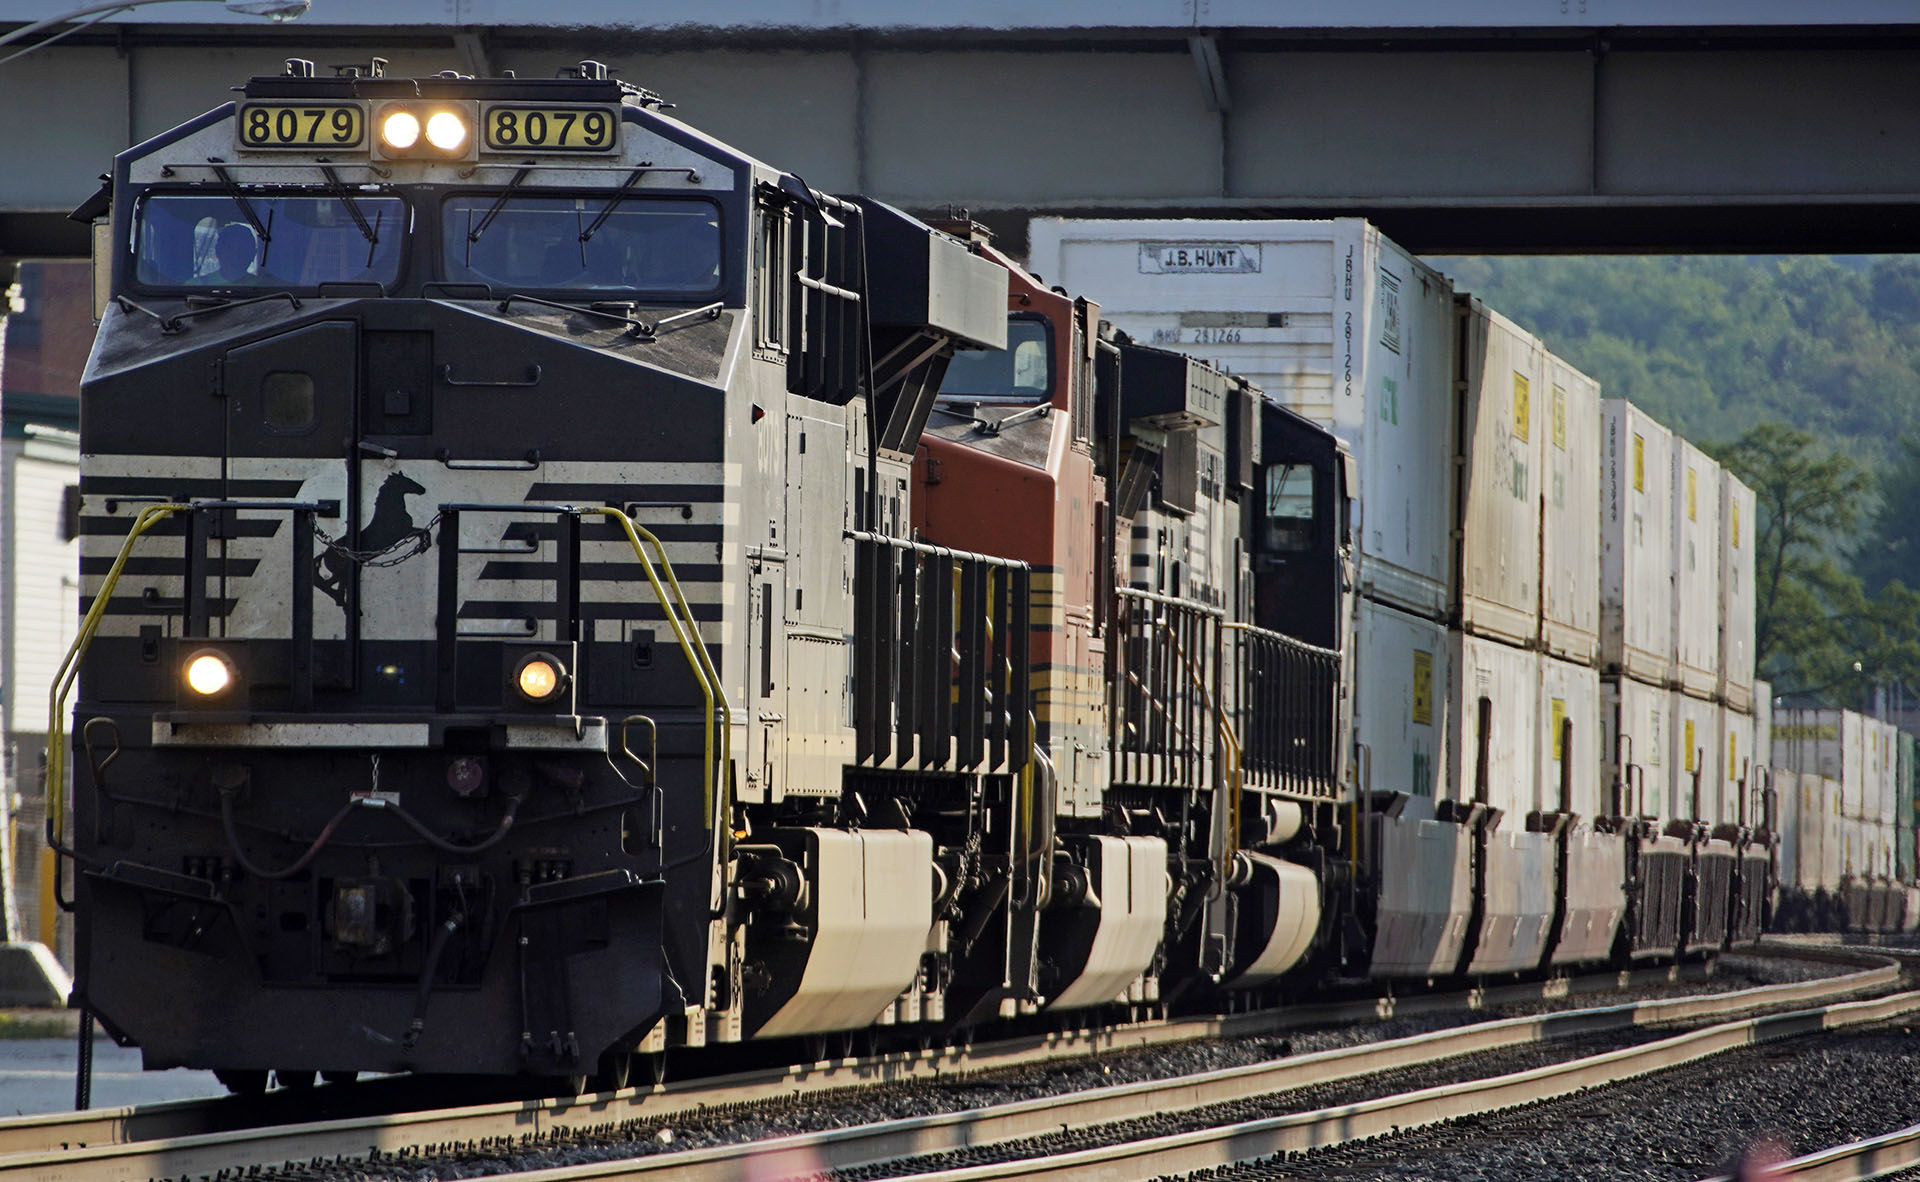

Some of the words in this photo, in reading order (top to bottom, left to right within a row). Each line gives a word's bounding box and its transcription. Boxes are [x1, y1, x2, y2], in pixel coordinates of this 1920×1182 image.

[248, 108, 354, 143] 8079
[496, 110, 606, 146] 8079
[1165, 250, 1193, 267] J.B.
[1195, 249, 1237, 267] HUNT
[1195, 329, 1241, 345] 281266
